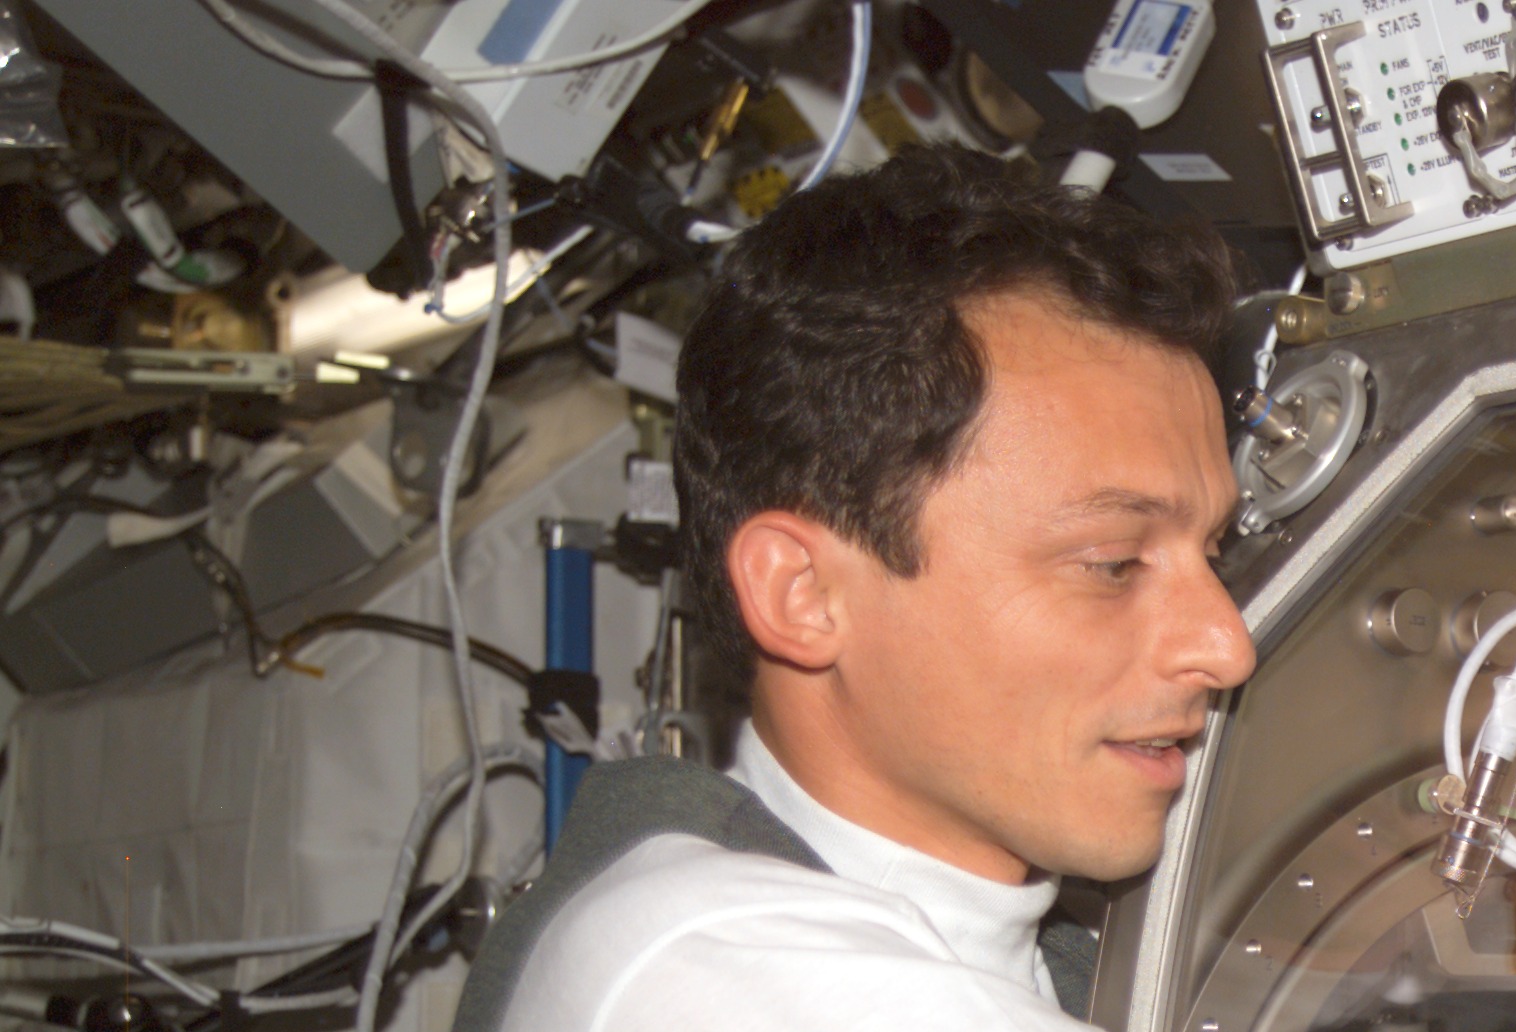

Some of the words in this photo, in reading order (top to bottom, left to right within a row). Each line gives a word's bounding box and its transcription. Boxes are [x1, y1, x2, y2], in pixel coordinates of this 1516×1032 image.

[1320, 9, 1344, 27] PWR
[1378, 12, 1421, 38] STATUS
[1483, 47, 1501, 61] TEST
